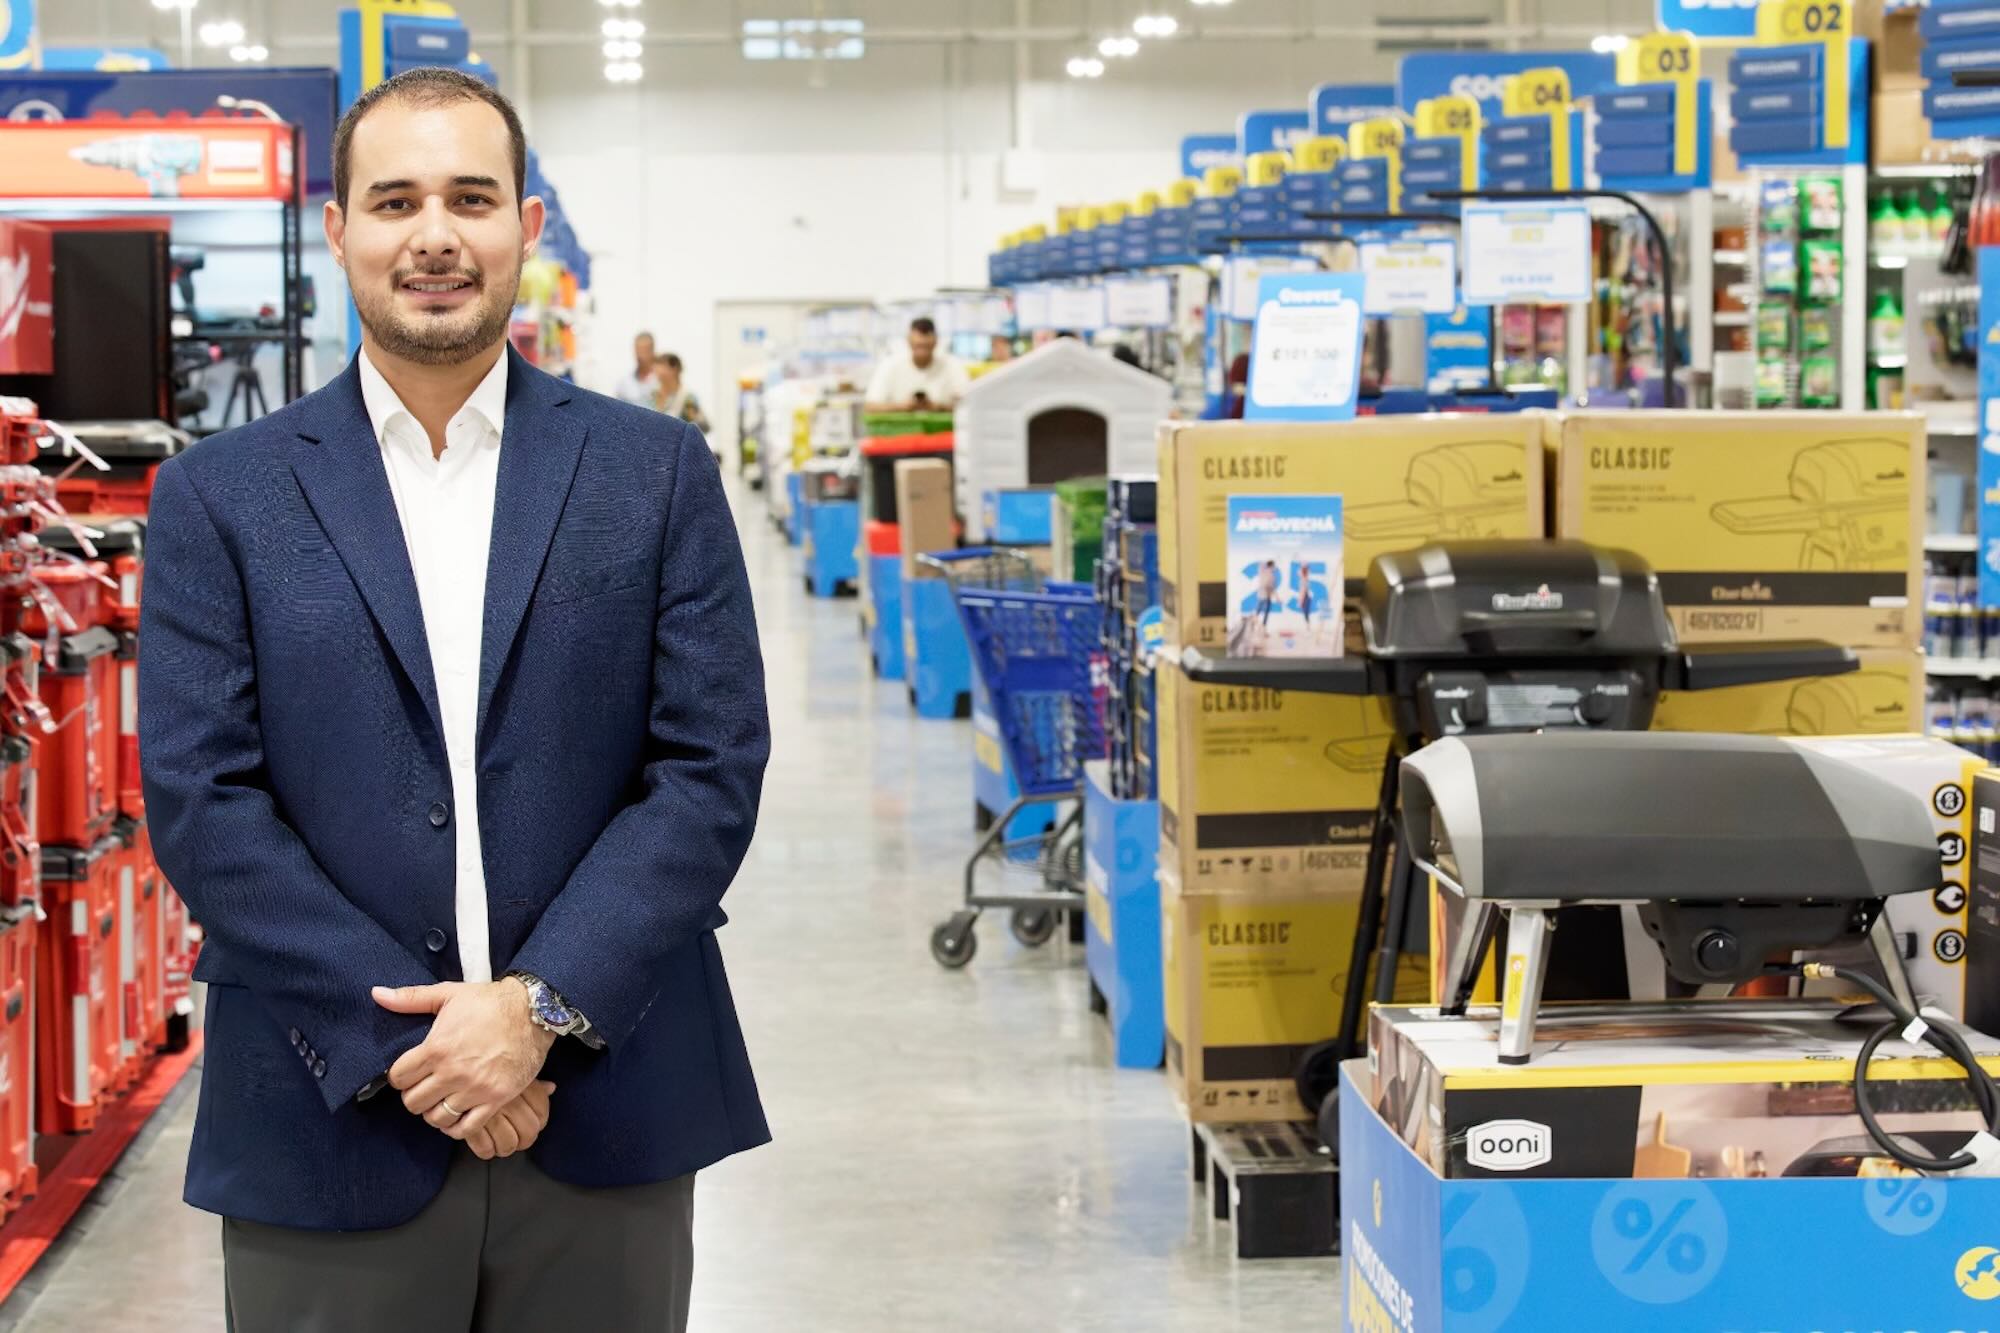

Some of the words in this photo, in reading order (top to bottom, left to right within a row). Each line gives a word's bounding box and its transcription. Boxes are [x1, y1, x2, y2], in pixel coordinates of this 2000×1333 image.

[1203, 456, 1285, 480] CLASSIC
[1590, 446, 1672, 470] CLASSIC
[1236, 514, 1336, 532] APROVECHÁ
[1241, 560, 1329, 614] 25
[1202, 688, 1283, 712] CLASSIC
[1208, 922, 1291, 946] CLASSIC
[1480, 1134, 1538, 1154] ooni
